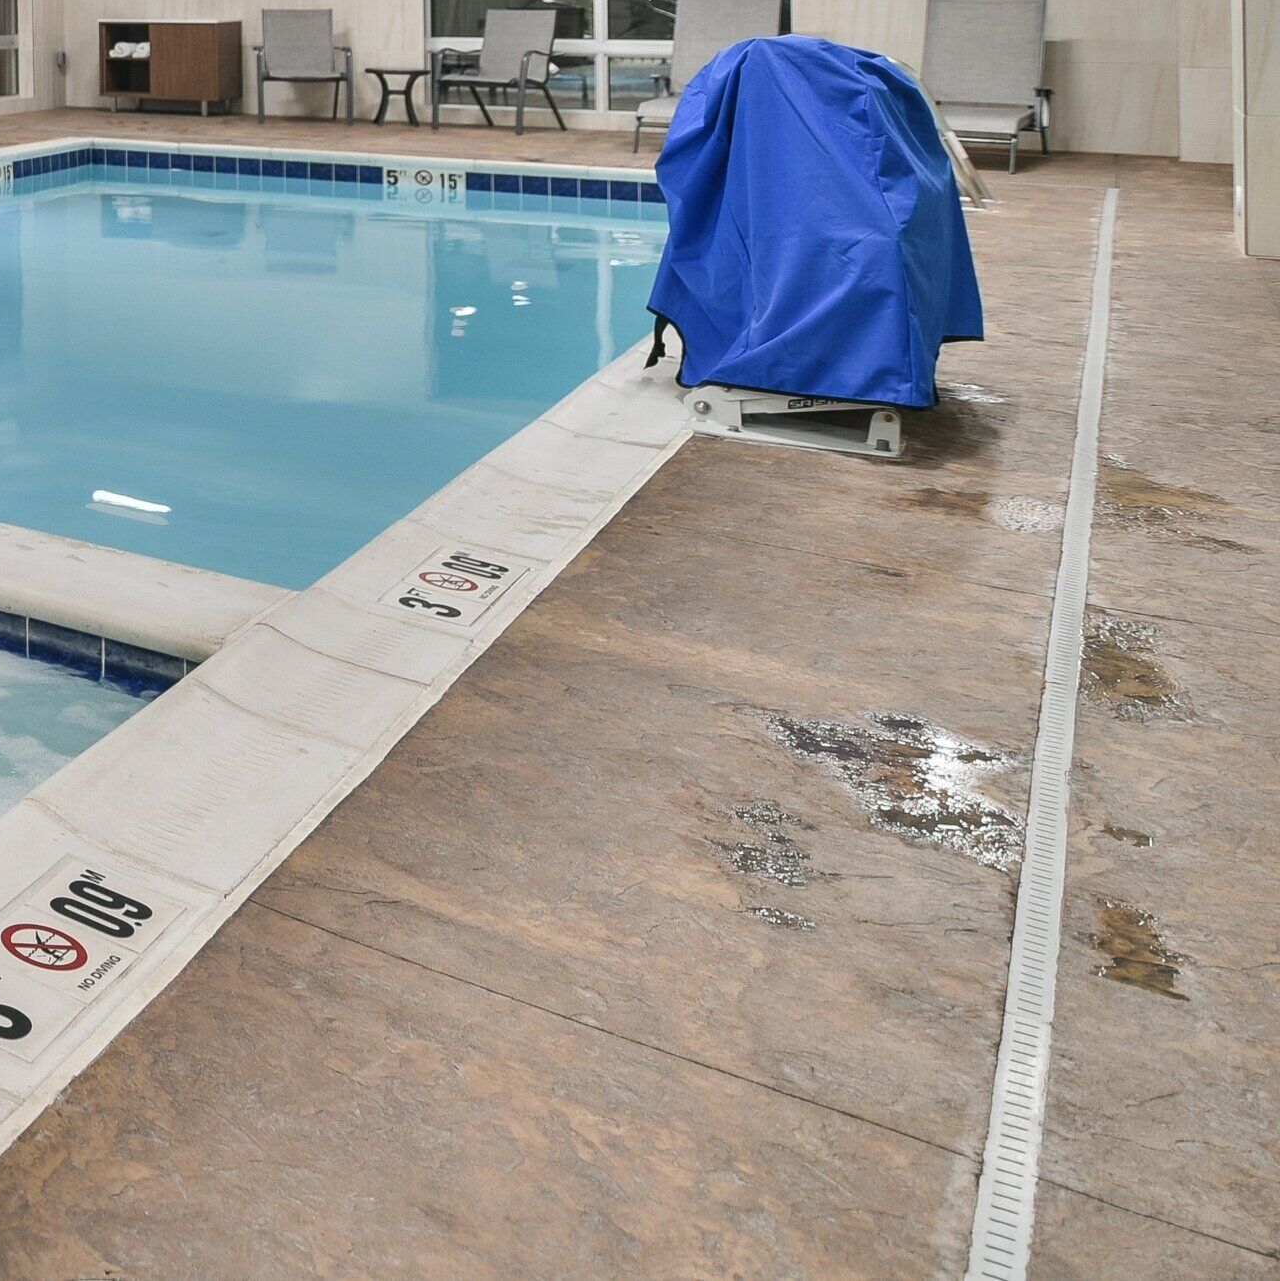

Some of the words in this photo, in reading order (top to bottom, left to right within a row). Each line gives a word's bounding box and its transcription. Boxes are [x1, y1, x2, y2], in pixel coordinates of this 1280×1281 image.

[49, 880, 153, 939] 0.9
[77, 976, 96, 992] NO
[95, 954, 122, 982] DIVING
